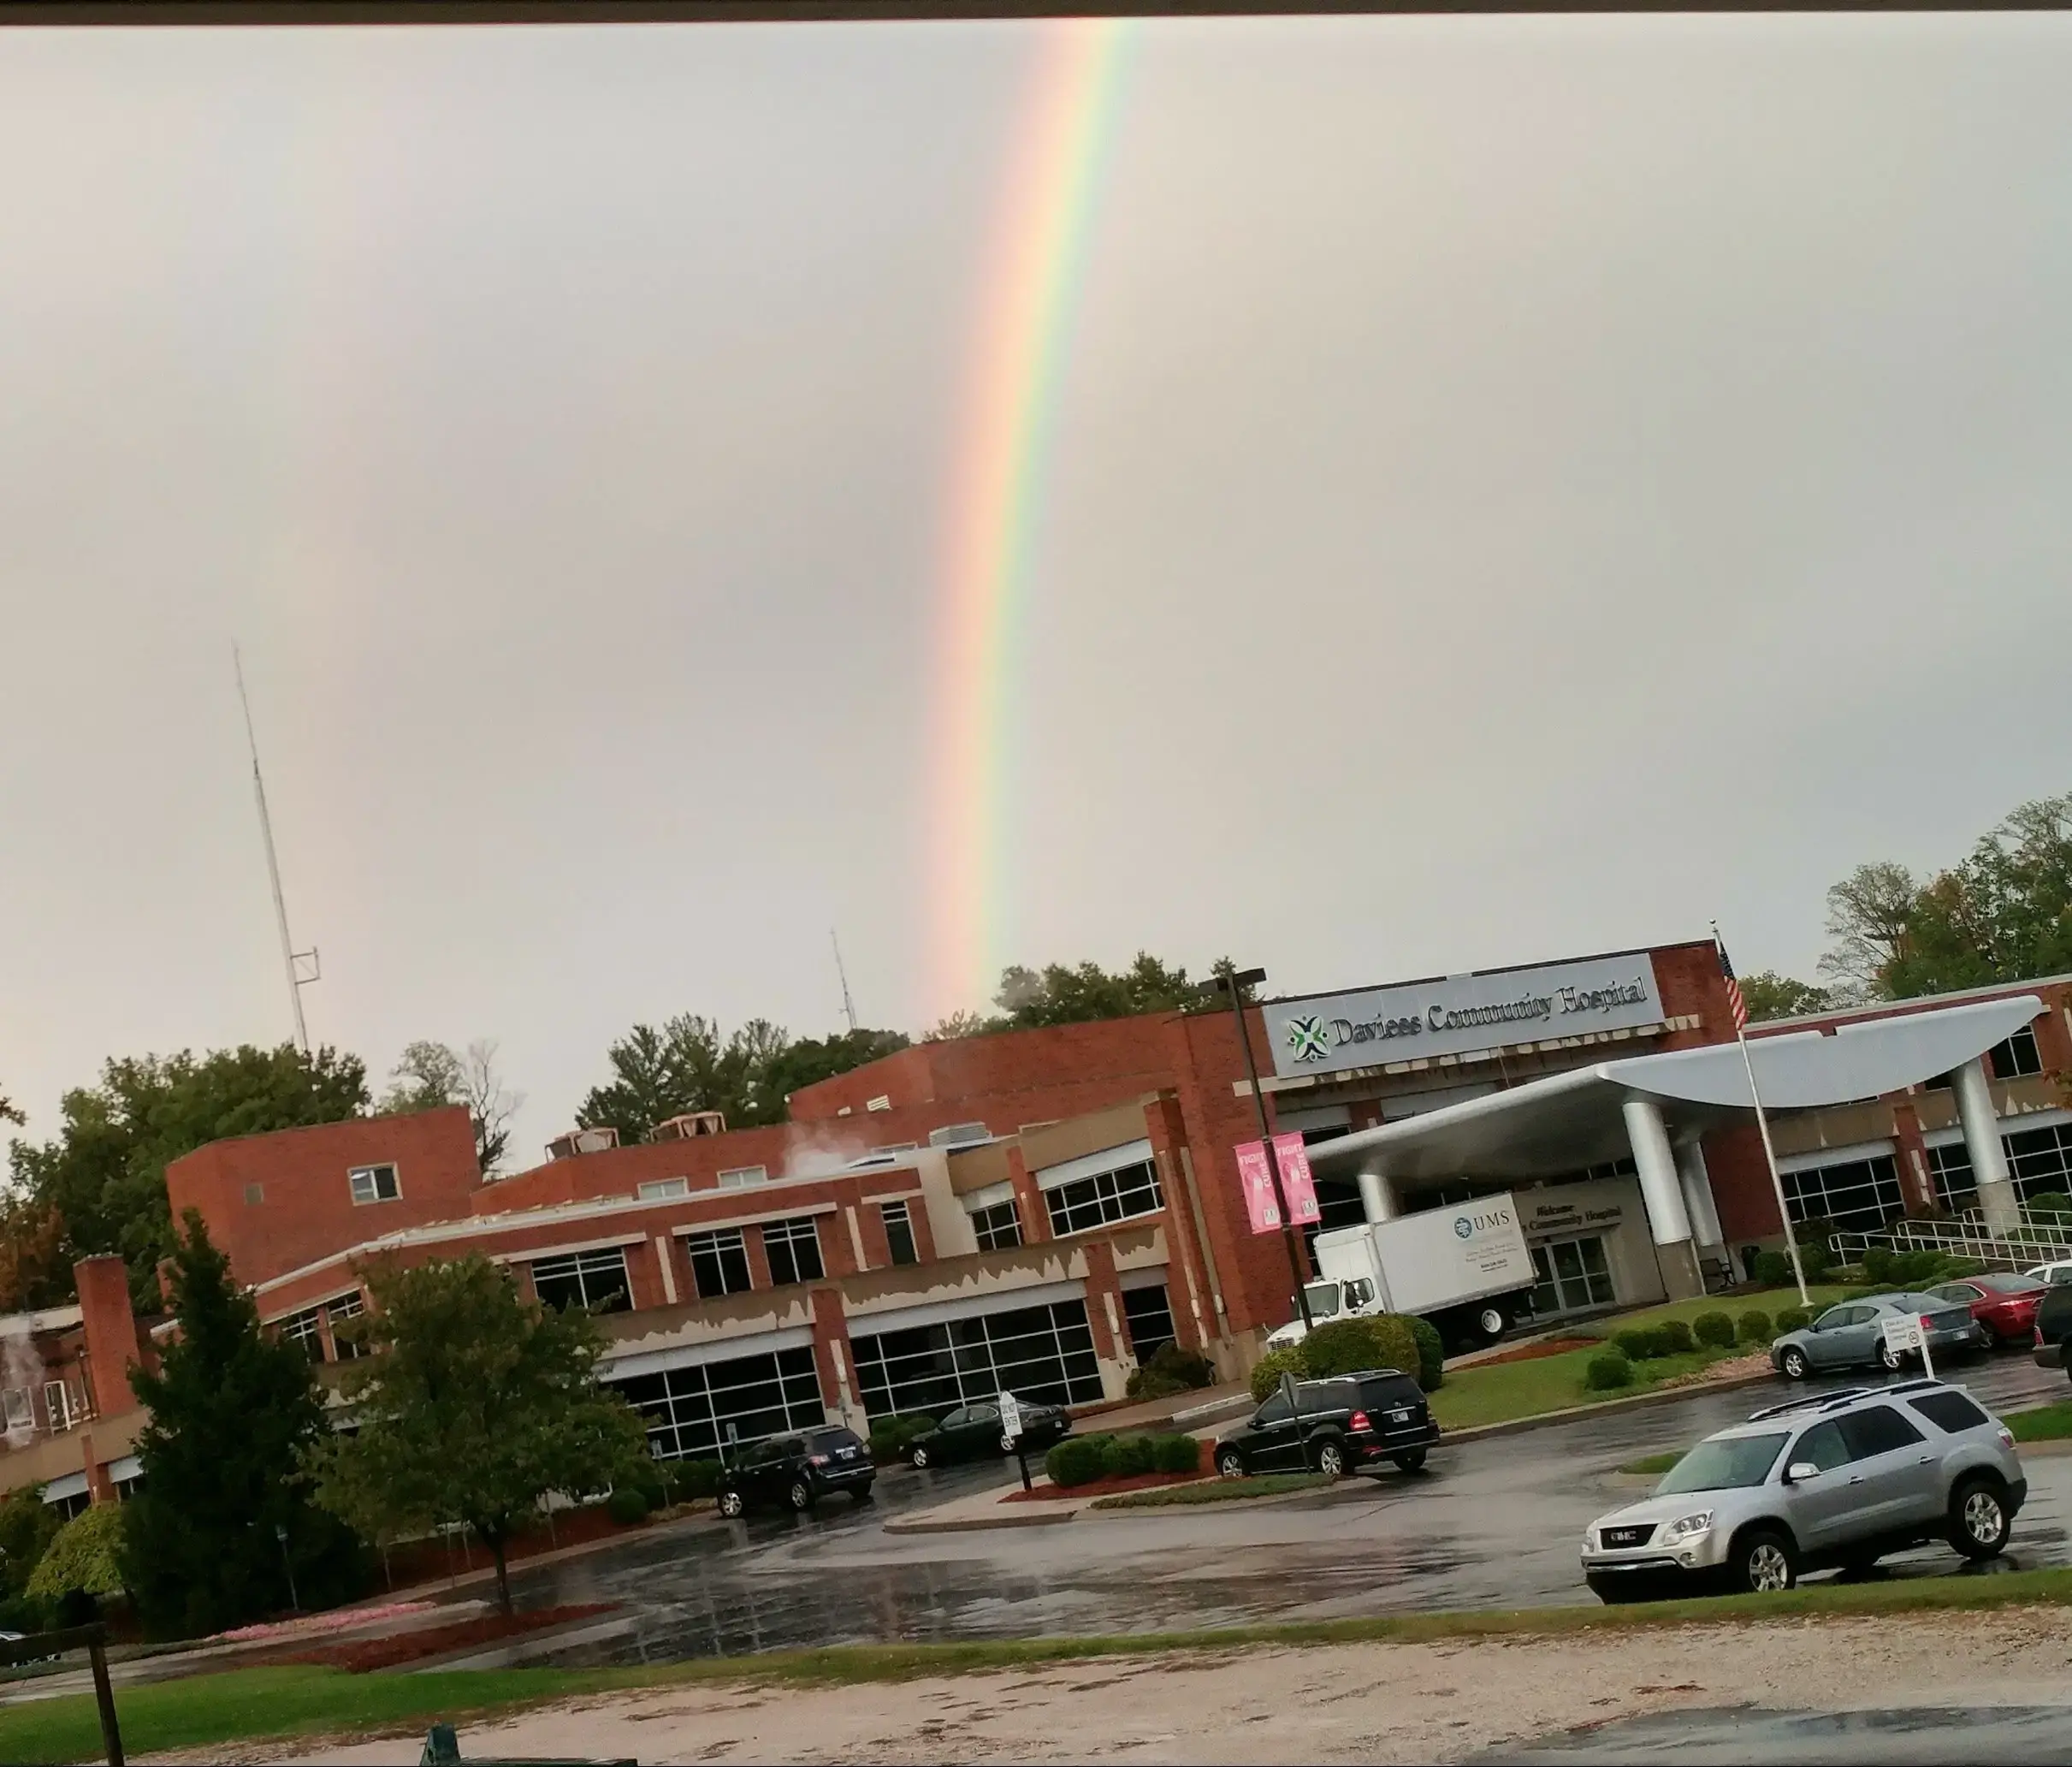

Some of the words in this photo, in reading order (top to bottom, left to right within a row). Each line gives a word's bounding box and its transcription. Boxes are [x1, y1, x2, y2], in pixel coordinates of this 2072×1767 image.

[1329, 1013, 1422, 1047] Daviess
[1428, 992, 1553, 1032] Community
[1556, 976, 1648, 1014] Hospital
[1473, 1210, 1510, 1230] UMS
[1610, 1530, 1637, 1541] GMC
